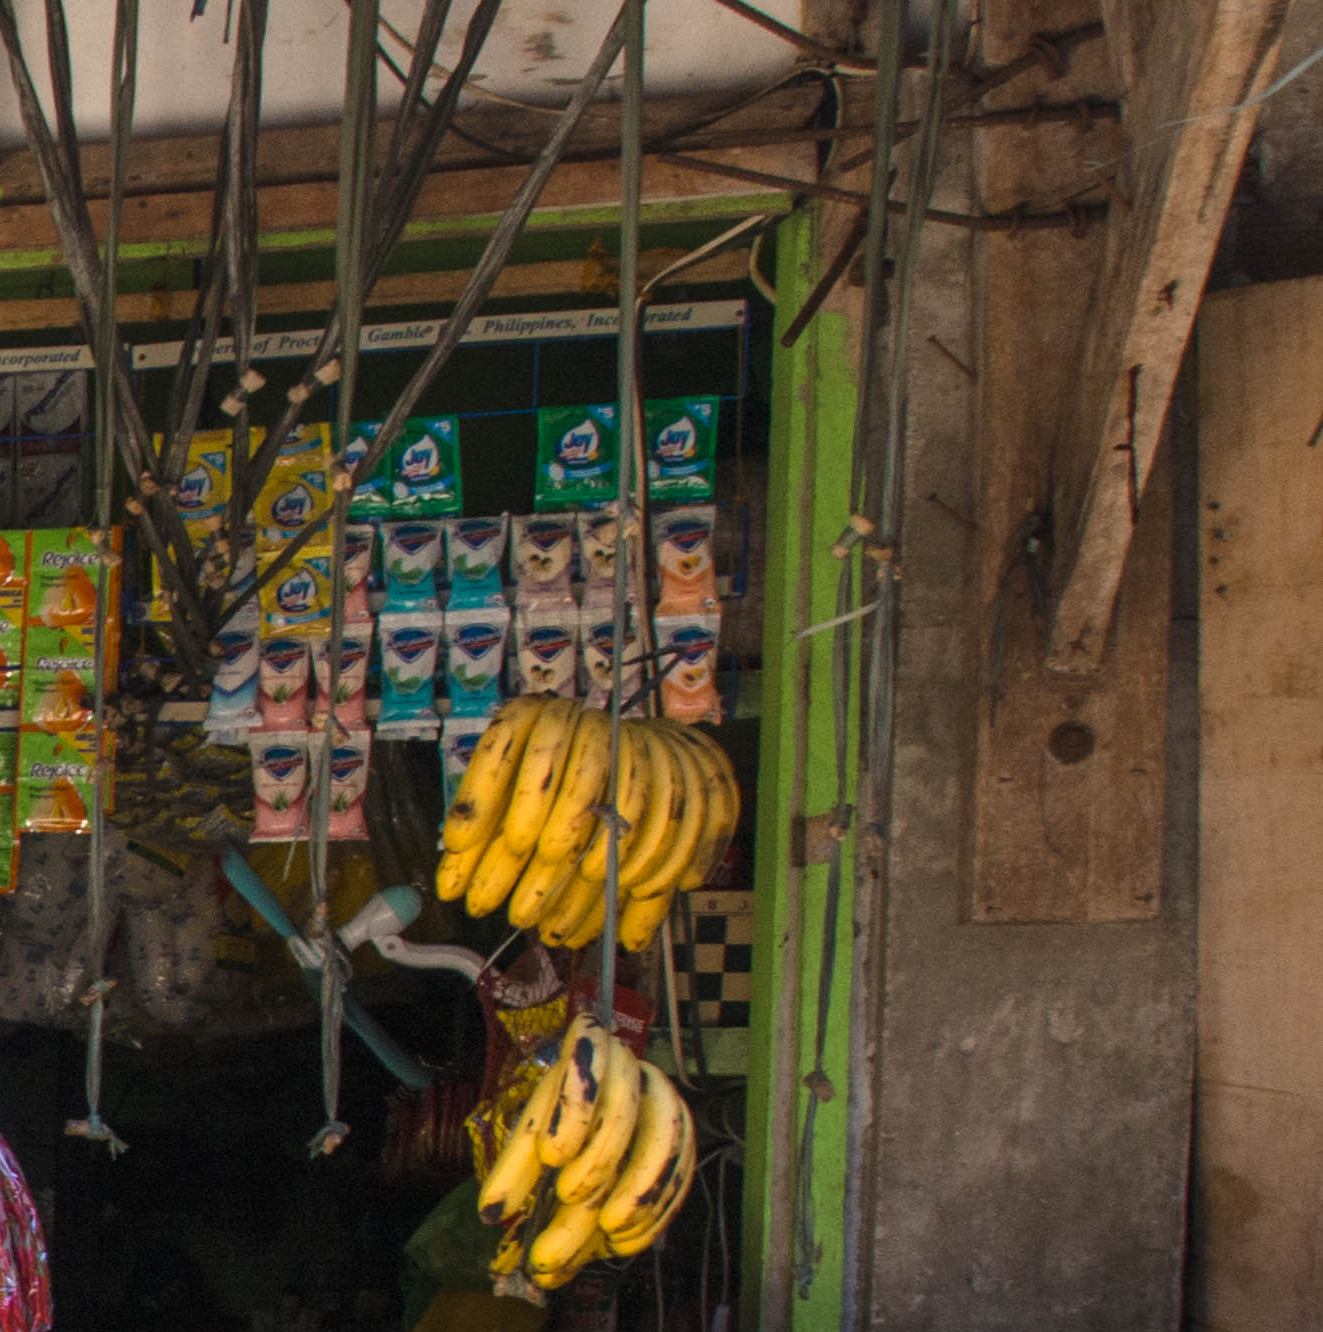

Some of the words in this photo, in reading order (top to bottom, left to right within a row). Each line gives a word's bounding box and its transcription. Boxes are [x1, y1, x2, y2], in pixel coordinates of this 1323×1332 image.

[280, 334, 325, 350] Proct
[42, 551, 100, 569] Rejoice
[35, 654, 94, 672] Rejoice
[30, 761, 89, 779] Rejoice
